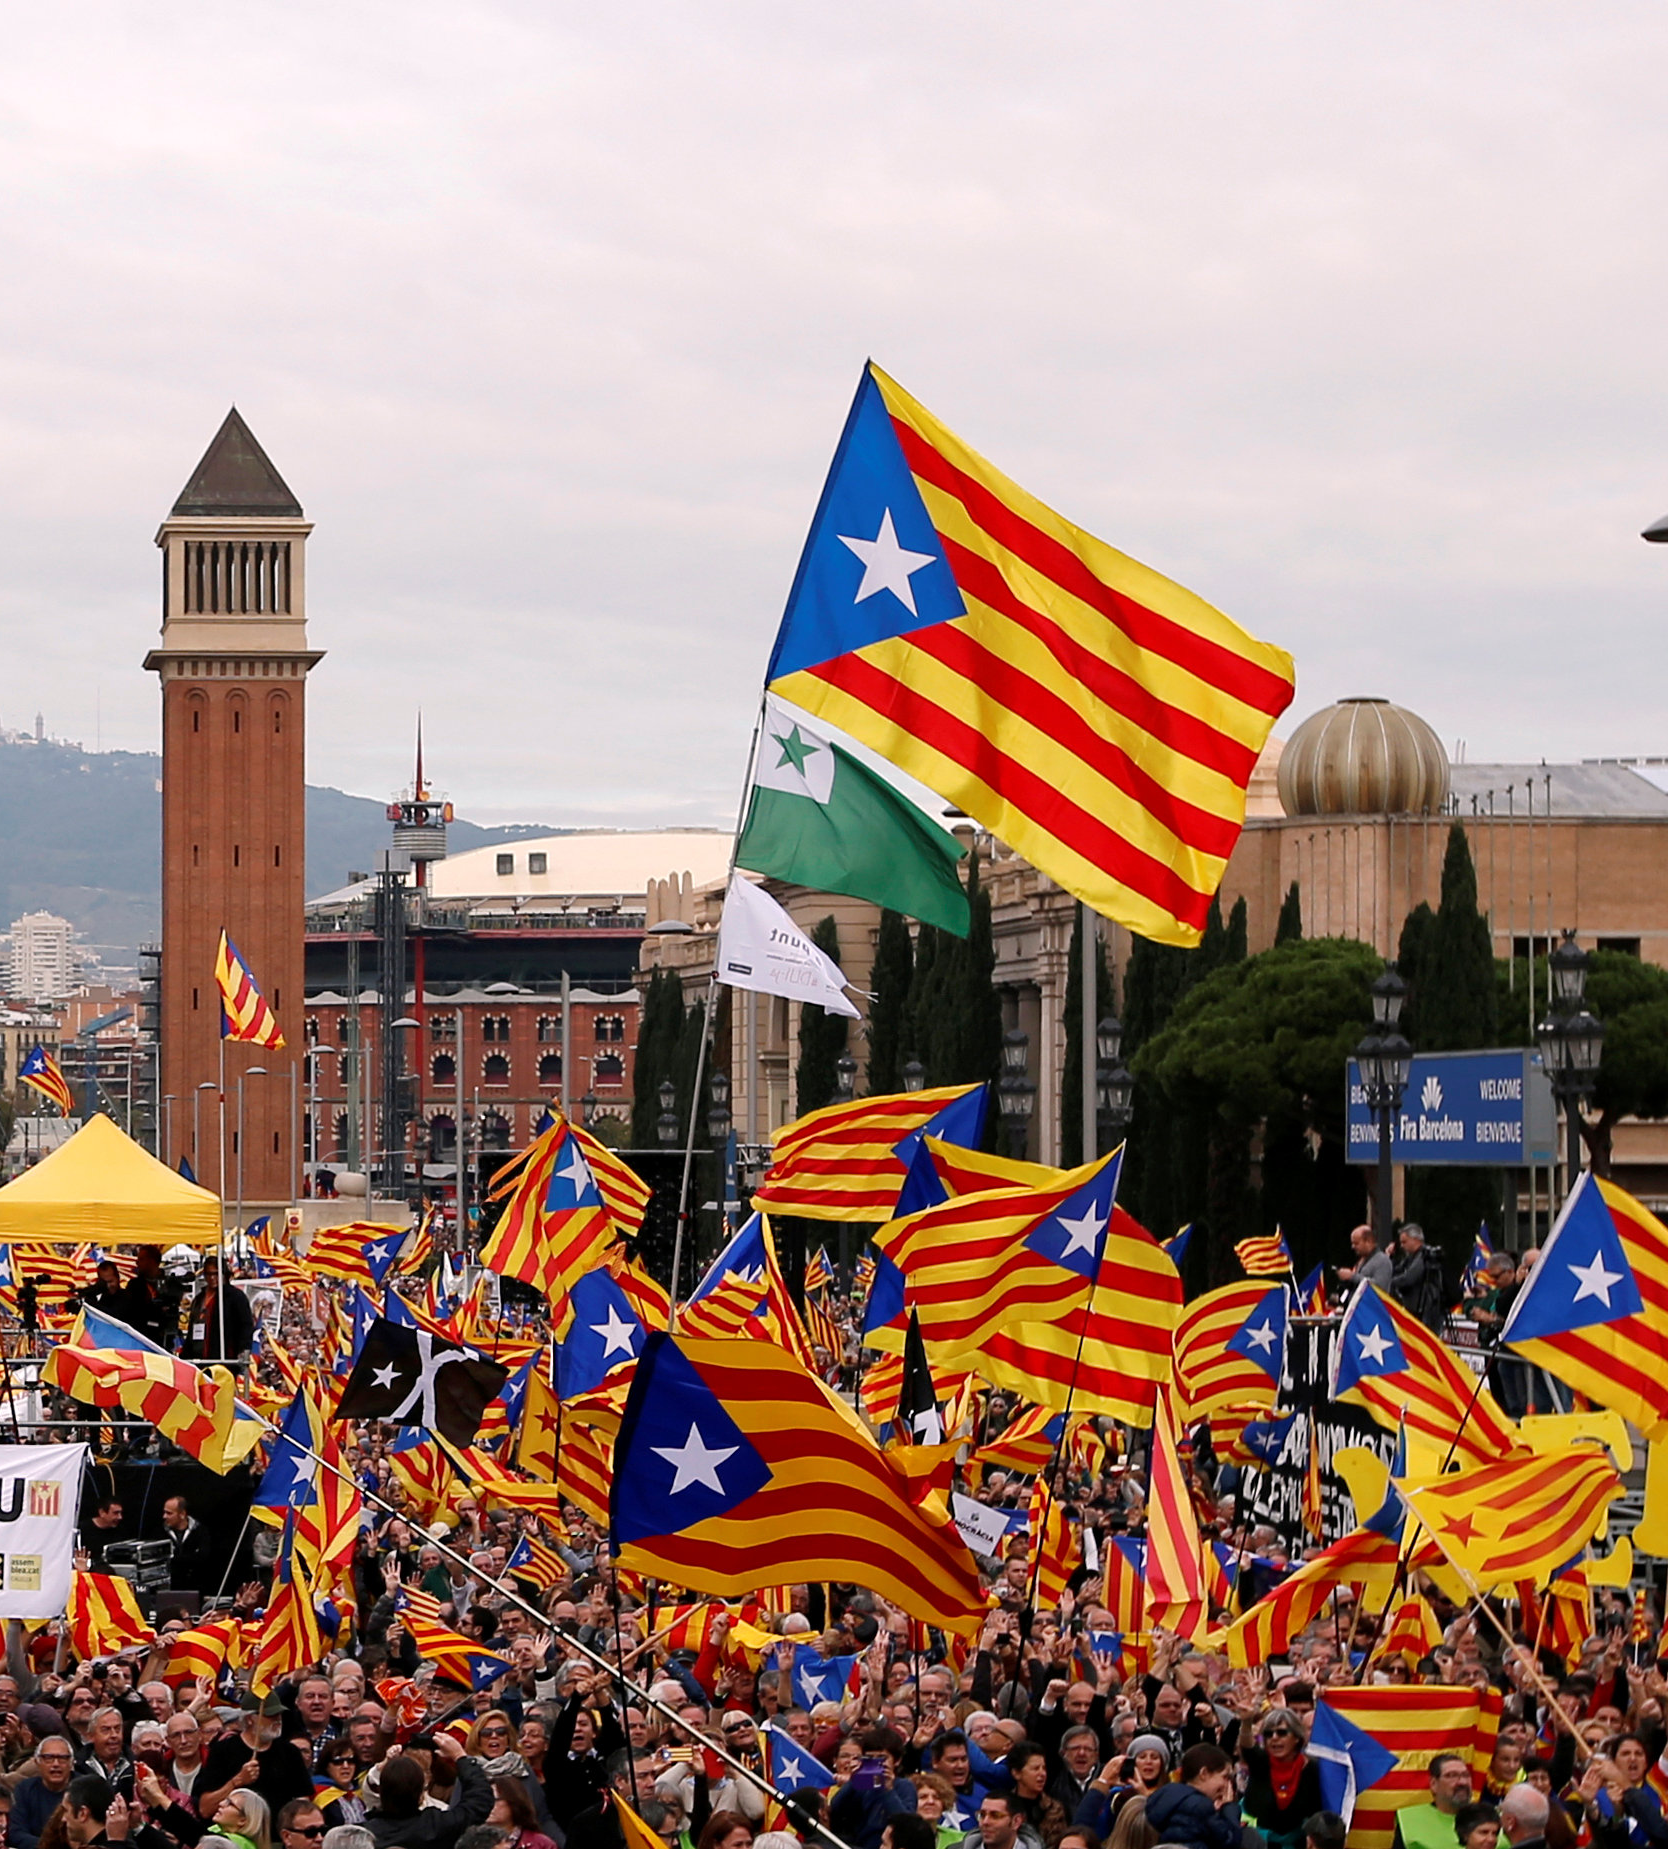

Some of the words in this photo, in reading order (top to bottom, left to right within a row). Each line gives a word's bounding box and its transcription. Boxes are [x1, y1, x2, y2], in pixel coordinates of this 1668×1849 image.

[1480, 1078, 1522, 1100] WELCOME
[1400, 1114, 1417, 1140] Fira
[1419, 1114, 1464, 1141] Barcelona
[1476, 1122, 1522, 1144] BIENVENUE
